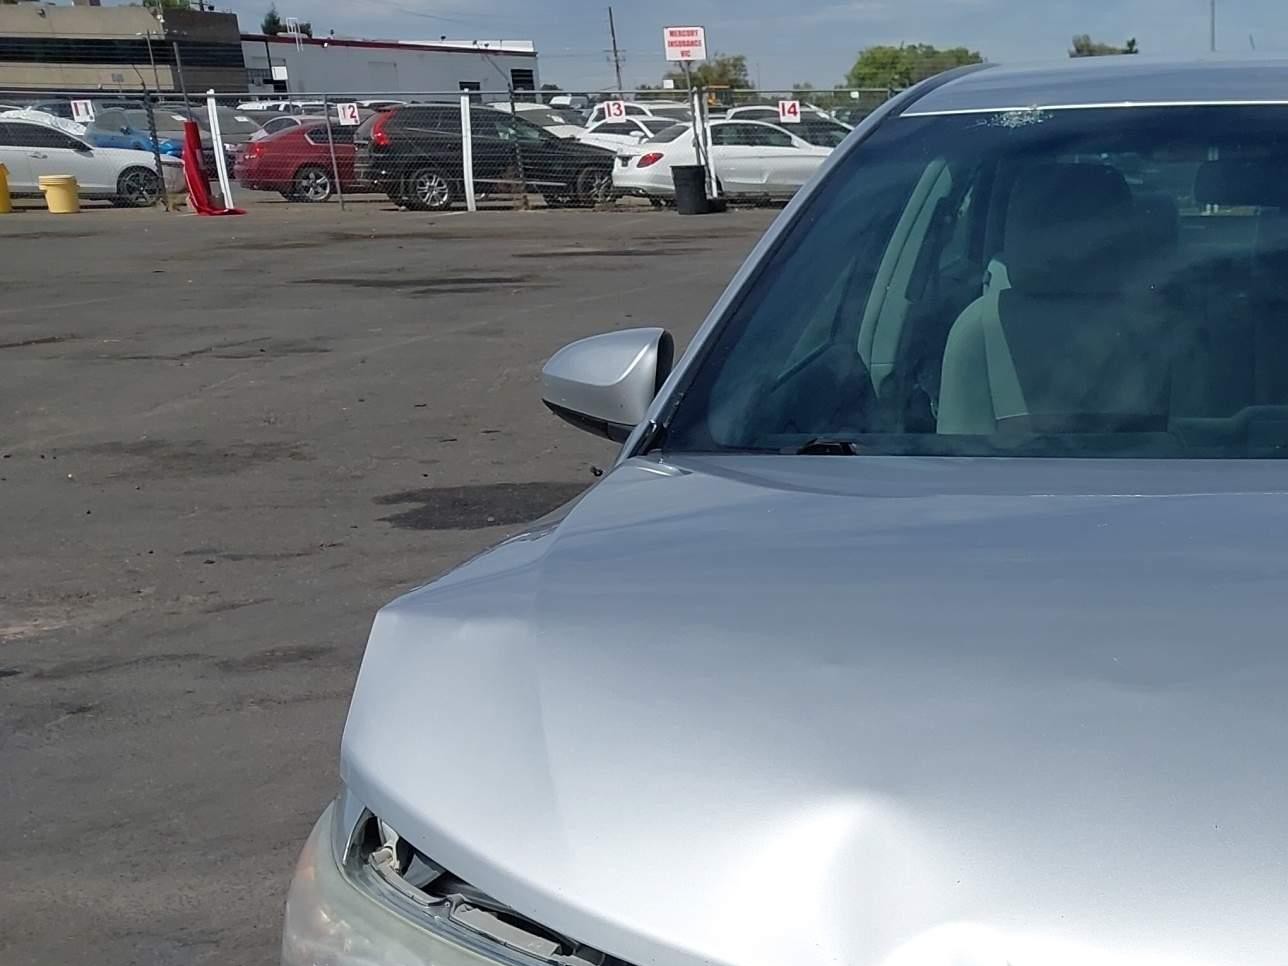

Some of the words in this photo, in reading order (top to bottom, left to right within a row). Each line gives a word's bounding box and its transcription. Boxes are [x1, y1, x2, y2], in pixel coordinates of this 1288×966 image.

[341, 104, 357, 118] 12
[606, 102, 623, 117] 13
[781, 102, 798, 116] 14
